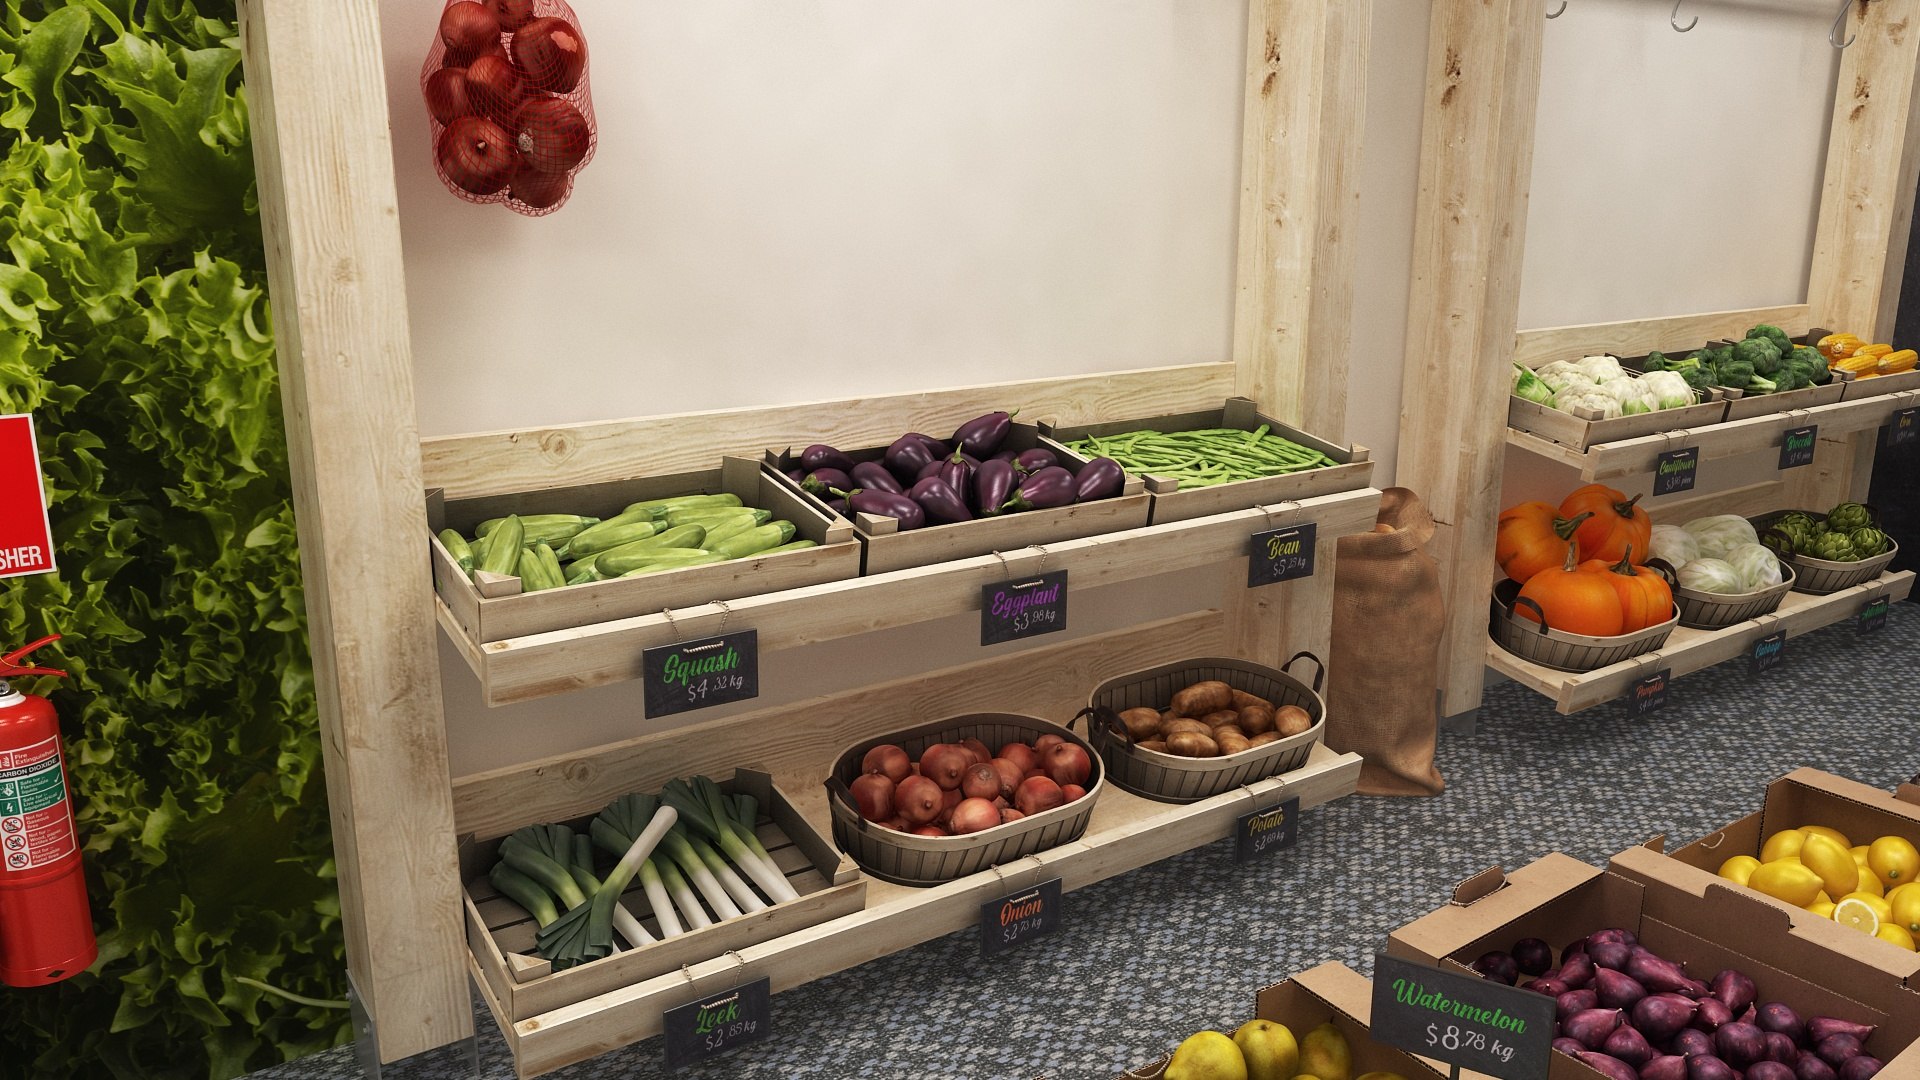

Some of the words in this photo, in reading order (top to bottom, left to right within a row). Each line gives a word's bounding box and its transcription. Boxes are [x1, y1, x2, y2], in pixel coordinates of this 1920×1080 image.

[1660, 459, 1695, 475] Cauliflower
[1267, 537, 1300, 560] Bean
[1298, 557, 1306, 569] kg
[992, 583, 1059, 619] Eggplant
[1045, 609, 1056, 623] kg
[663, 646, 740, 687] Squash
[729, 674, 743, 690] kg
[15, 748, 55, 765] Extinguisher
[28, 758, 57, 773] DIOXIDE
[20, 779, 49, 790] Flammable
[24, 800, 51, 812] equipment
[1247, 813, 1284, 837] Potato
[32, 848, 60, 860] Flammable
[1000, 899, 1043, 927] Onion
[1031, 918, 1042, 930] kg
[1392, 978, 1527, 1034] Watermelon
[695, 1001, 741, 1034] Leek
[743, 1020, 757, 1033] kg
[1425, 1022, 1486, 1051] $8.78
[1490, 1039, 1517, 1063] kg
